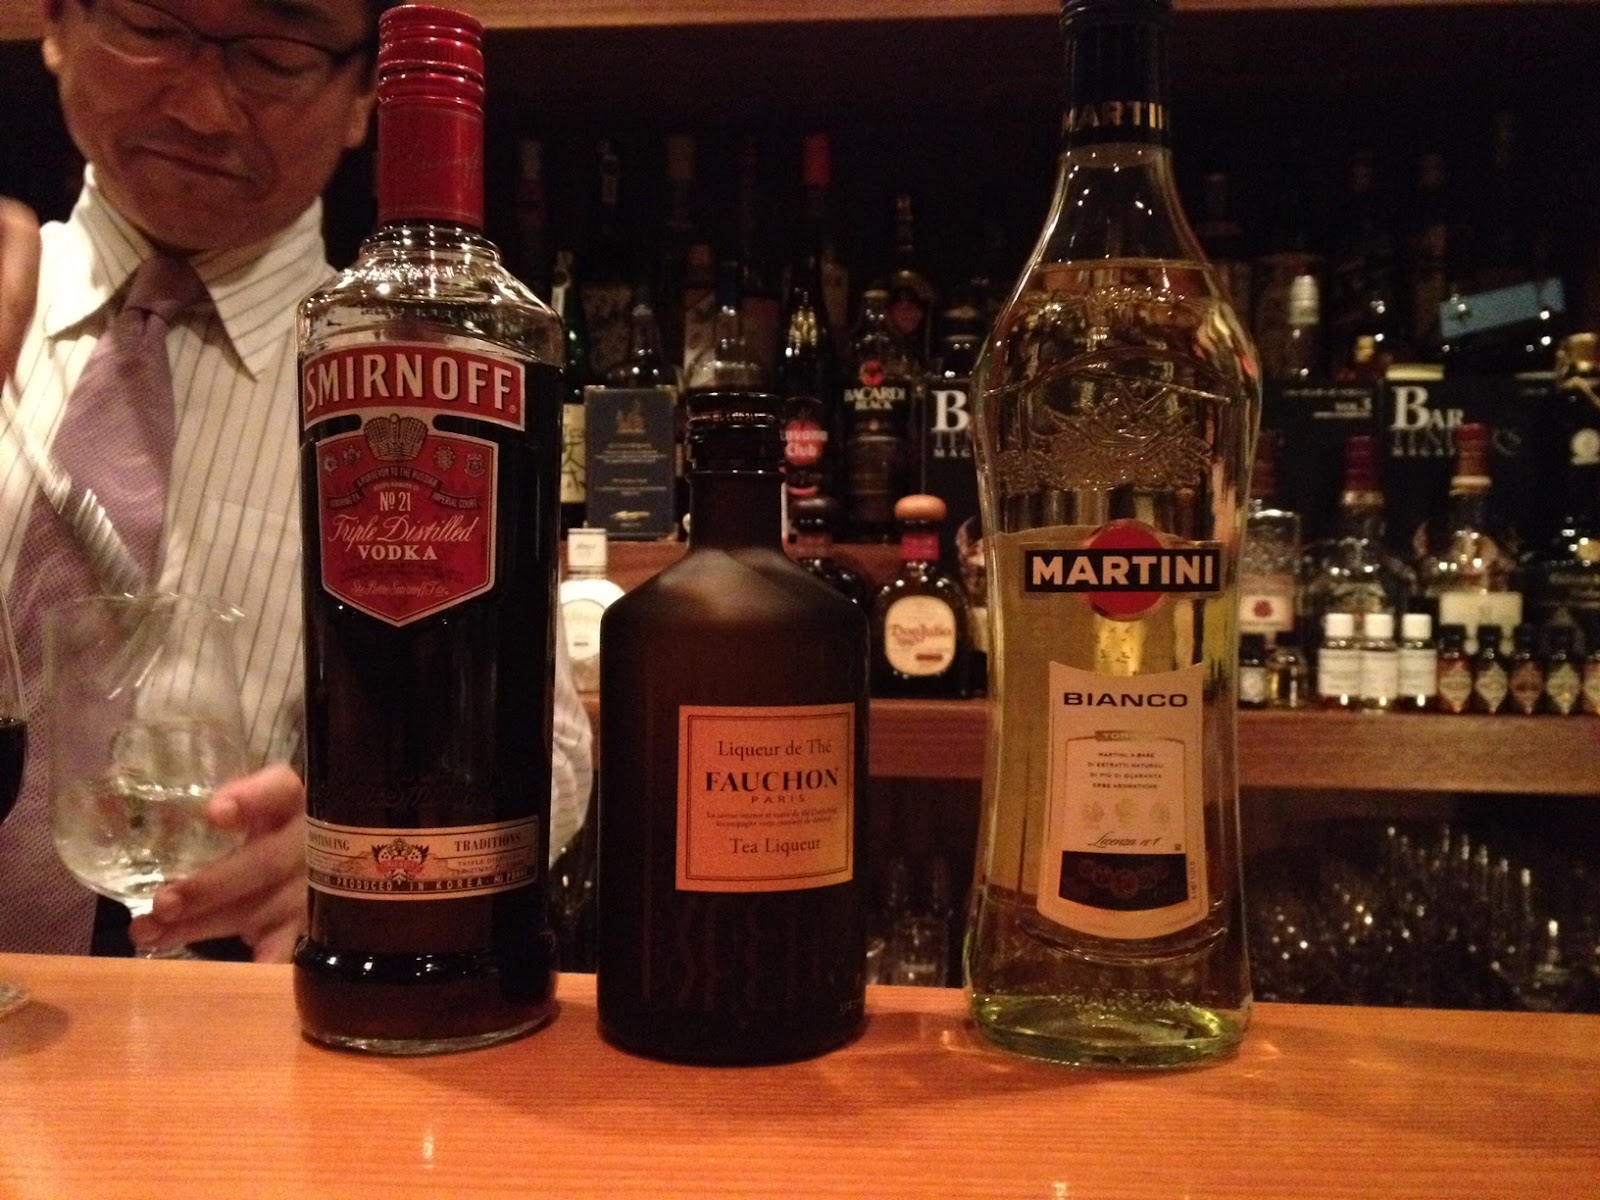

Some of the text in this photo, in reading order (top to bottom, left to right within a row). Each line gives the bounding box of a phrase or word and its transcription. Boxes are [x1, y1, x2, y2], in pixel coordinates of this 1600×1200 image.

[304, 353, 513, 413] SMIRNOFF
[399, 492, 411, 512] 21
[328, 514, 479, 552] Triple Distilled
[358, 545, 438, 561] VODKA
[1032, 555, 1213, 586] MARTINI
[1063, 692, 1188, 708] BIANCO
[718, 740, 780, 761] Liqueur
[785, 740, 802, 756] de
[705, 768, 838, 792] FAUCHON
[751, 794, 805, 804] PARIS
[454, 832, 522, 853] TRADITIONS
[729, 838, 821, 857] Tea Liqueur
[336, 877, 394, 892] PRODUCED
[409, 880, 425, 891] IN
[435, 877, 483, 891] KOREA
